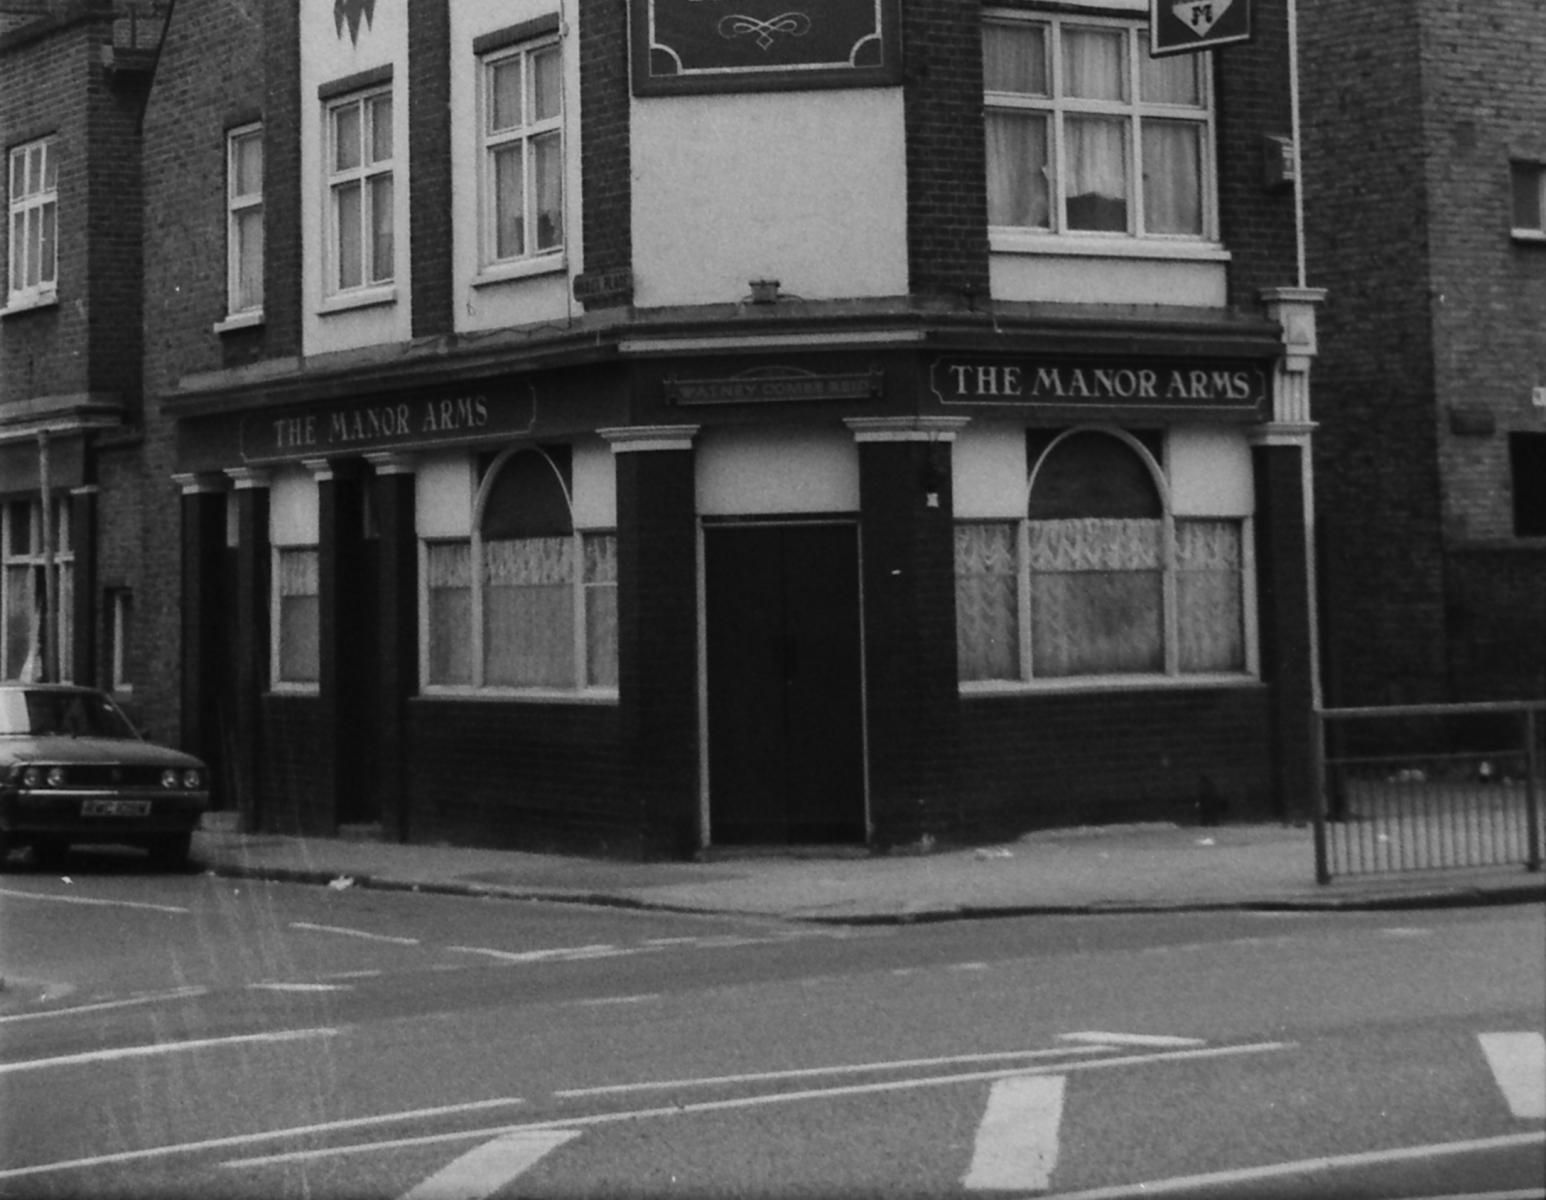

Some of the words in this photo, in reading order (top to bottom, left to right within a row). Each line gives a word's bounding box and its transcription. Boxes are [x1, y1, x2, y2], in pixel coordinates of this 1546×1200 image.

[1192, 4, 1213, 25] M
[950, 365, 1021, 395] THE
[1031, 368, 1158, 397] MANOR
[1165, 369, 1250, 399] ARMS
[273, 415, 317, 447] THE
[328, 403, 410, 443] MANOR
[422, 395, 488, 432] ARMS
